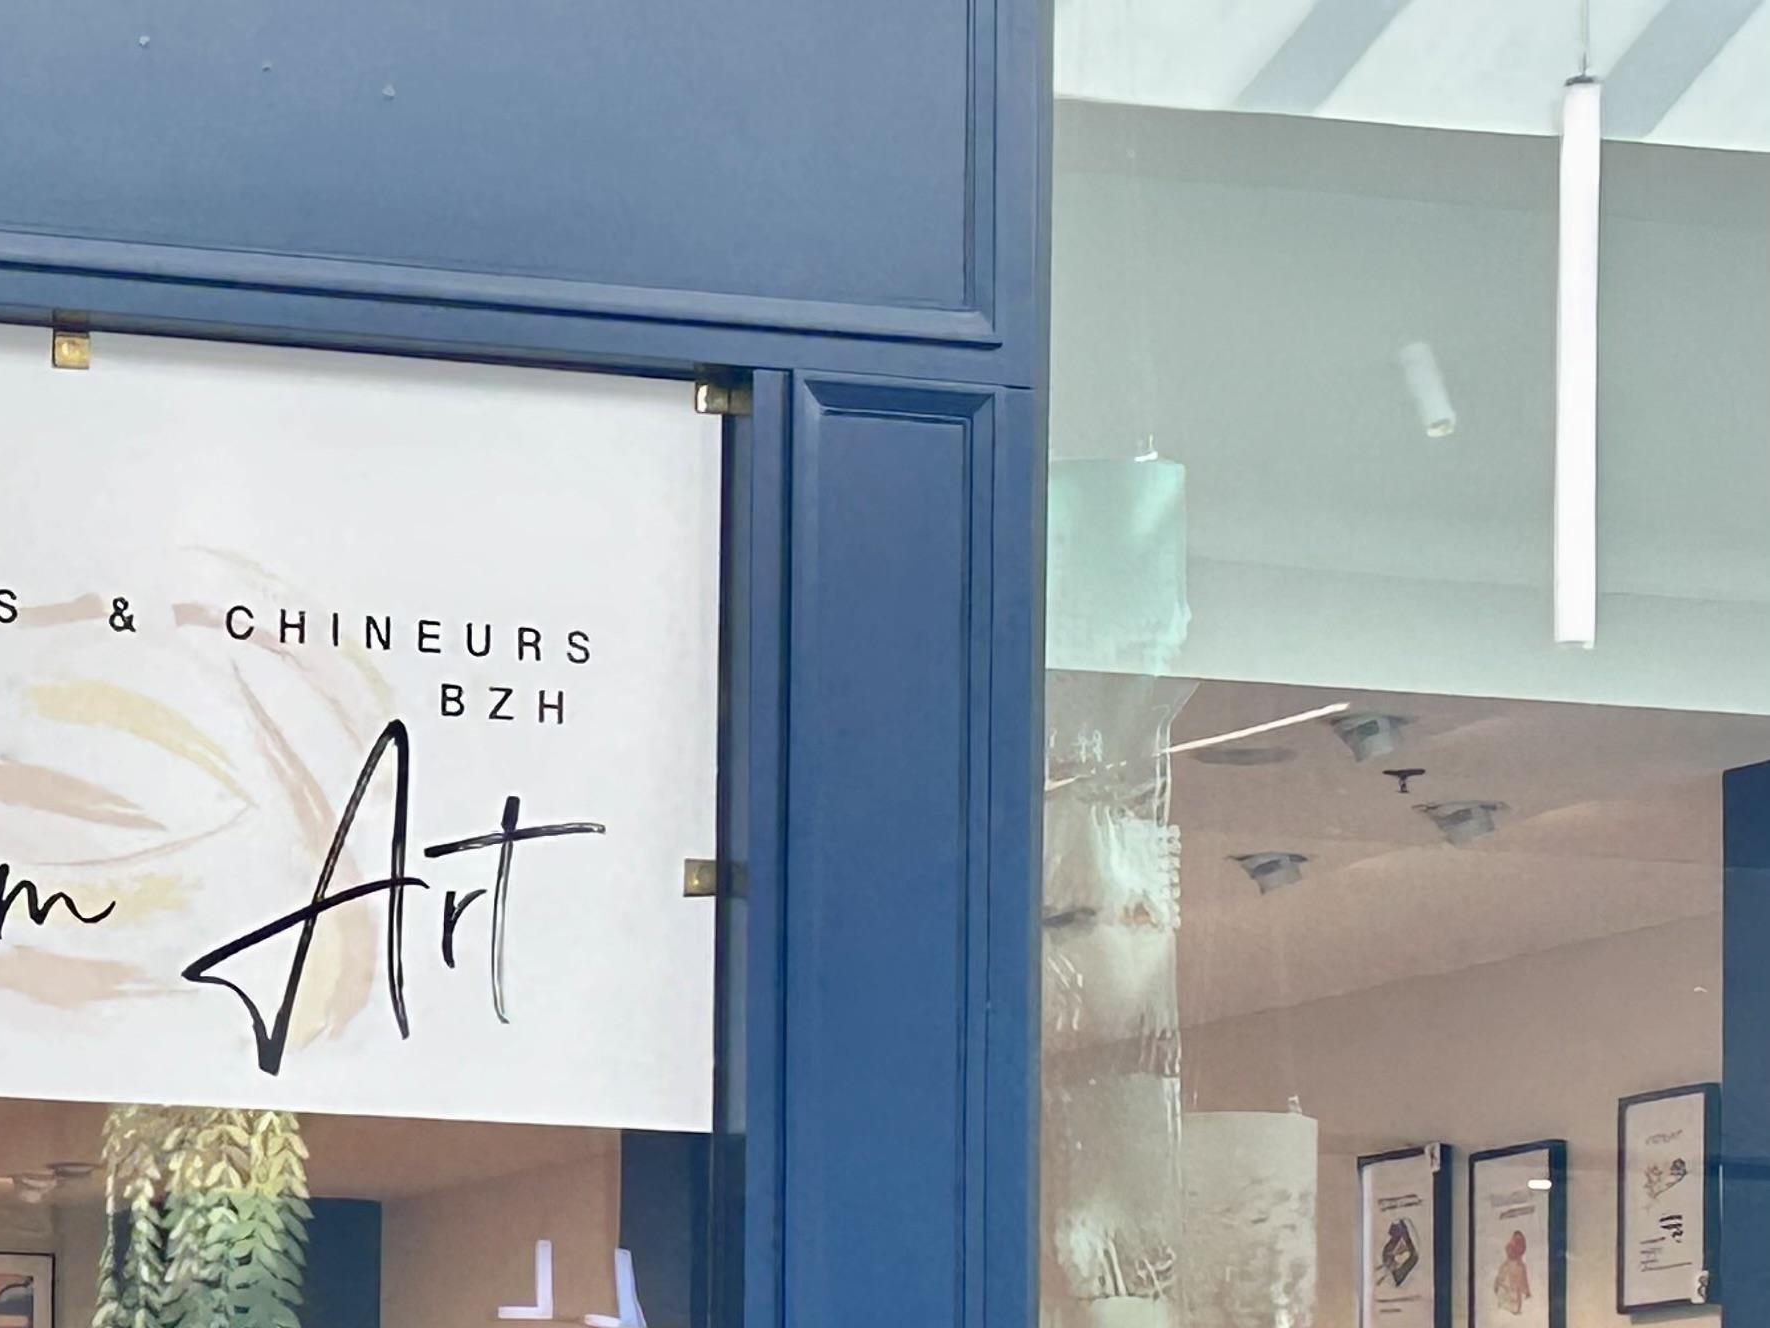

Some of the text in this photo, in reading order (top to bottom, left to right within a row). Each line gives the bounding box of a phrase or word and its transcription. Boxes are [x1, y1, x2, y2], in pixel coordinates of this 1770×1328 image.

[108, 596, 136, 633] &
[225, 605, 591, 664] CHINEURS
[440, 683, 565, 725] BZH
[181, 719, 606, 1076] Art
